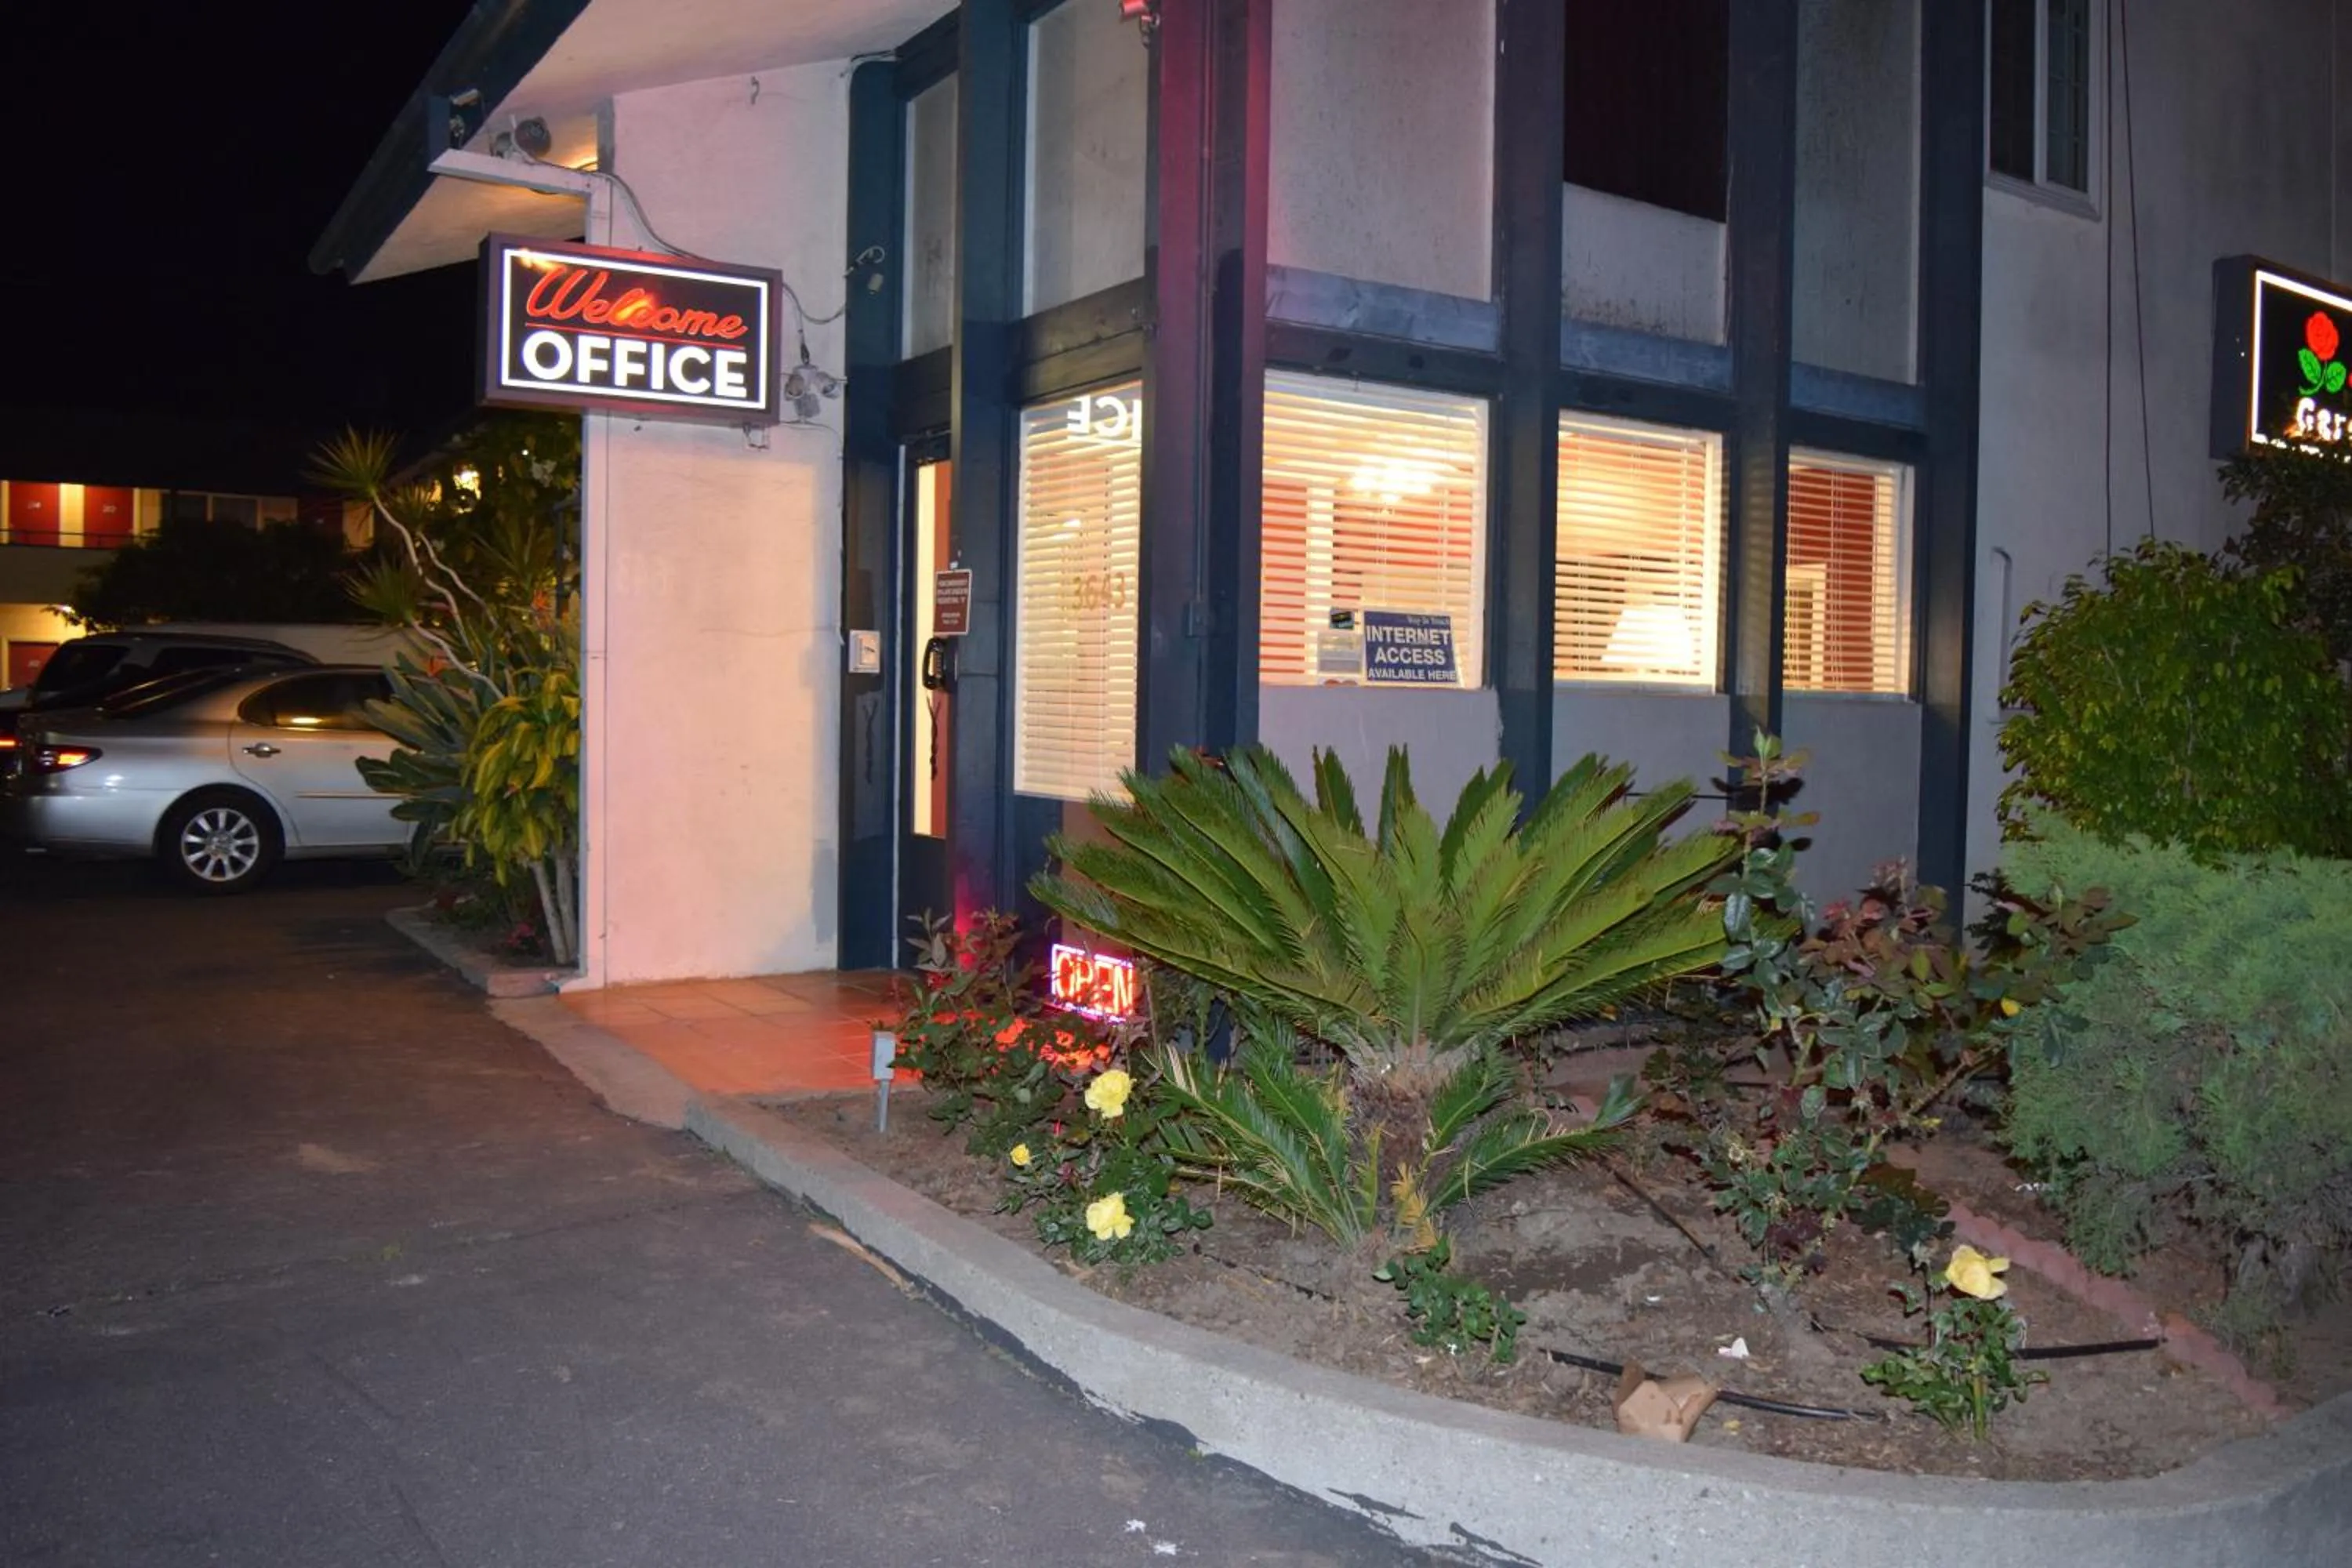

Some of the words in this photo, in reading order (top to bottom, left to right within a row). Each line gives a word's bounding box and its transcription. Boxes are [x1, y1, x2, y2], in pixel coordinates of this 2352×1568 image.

[526, 266, 749, 339] Welcome
[521, 330, 748, 398] OFFICE
[1366, 625, 1450, 645] INTERNET
[1374, 647, 1446, 665] ACCESS
[1367, 667, 1426, 680] AVAILABLE
[1428, 670, 1458, 681] HERE
[1055, 952, 1134, 1016] OPEN
